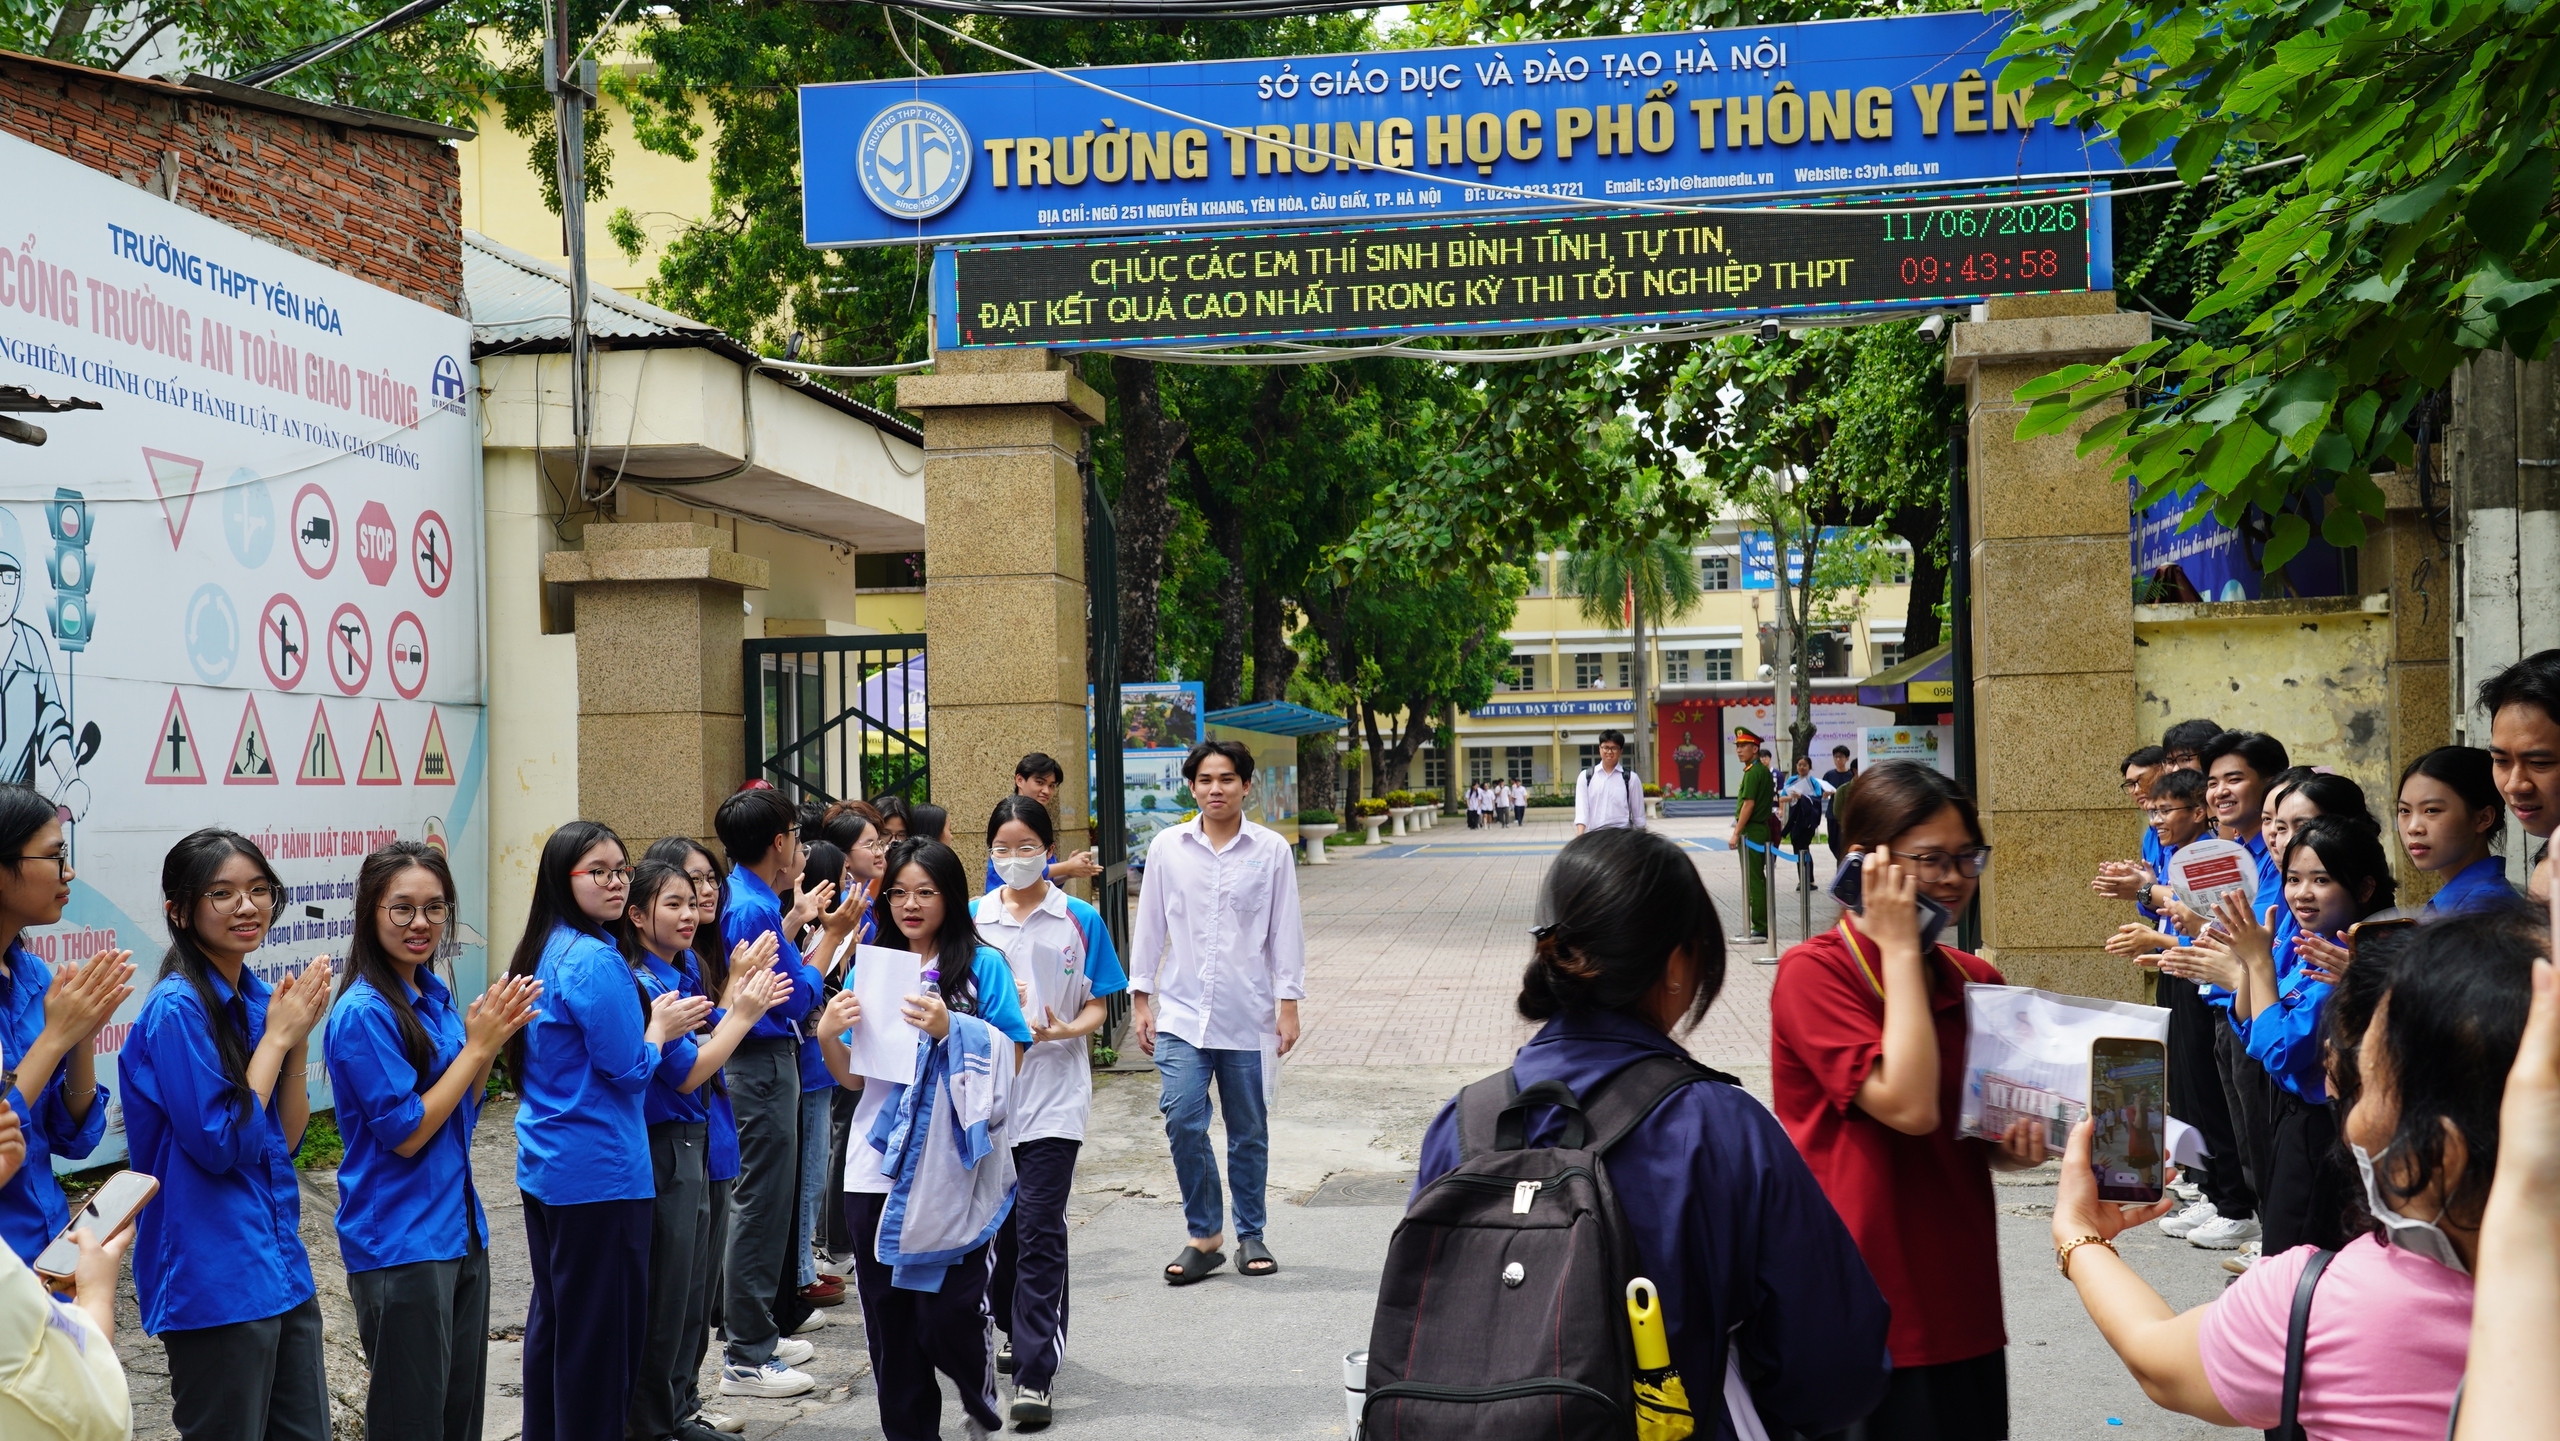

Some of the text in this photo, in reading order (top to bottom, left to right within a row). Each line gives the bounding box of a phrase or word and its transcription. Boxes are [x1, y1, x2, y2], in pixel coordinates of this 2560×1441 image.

[1258, 36, 1787, 99] SỞ GIÁO DỤC VÀ ĐÀO TẠO HÀ NỘI
[867, 109, 958, 152] TRƯỜNG THPT YÊN HÒA
[984, 118, 1209, 188] TRƯỜNG
[1223, 116, 1415, 177] TRUNG
[1426, 109, 1543, 175] HỌC
[1556, 79, 1679, 159] PHỔ
[1690, 80, 1894, 152] THÔNG
[1911, 68, 2036, 136] YÊN
[895, 194, 939, 210] since 1960
[1038, 208, 1060, 227] ĐỊA
[1091, 205, 1118, 221] NGÕ
[1121, 205, 1144, 220] 251
[1147, 197, 1198, 219] NGUYỄN
[1201, 200, 1248, 217] KHANG,
[1251, 196, 1275, 213] YÊN
[1278, 194, 1308, 213] HÒA,
[1310, 192, 1336, 210] CẦU
[1339, 190, 1370, 210] GIẤY,
[1374, 192, 1394, 207] TP.
[1396, 187, 1415, 205] HÀ
[1418, 188, 1442, 208] NỘI
[1464, 187, 1485, 202] ĐT:
[1552, 181, 1583, 197] 3721
[1605, 177, 1645, 194] Email:
[1794, 164, 1853, 183] Website:
[1854, 161, 1940, 180] c3yh.edu.vn
[1883, 203, 2077, 241] 11/06/2026
[1091, 249, 1179, 284] CHÚC
[1186, 246, 1247, 280] CÁC
[1254, 250, 1299, 277] EM
[1305, 238, 1358, 274] THÍ
[1366, 242, 1438, 272] SINH
[1448, 232, 1523, 267] BÌNH
[1622, 229, 1669, 262] TỰ
[1672, 226, 1731, 256] TIN,
[1901, 250, 2058, 284] 09:43:58
[107, 222, 343, 336] TRƯỜNG THPT YÊN HÒA
[978, 258, 1855, 333] ĐẠT KẾT QUẢ CAO NHẤT TRONG KỲ THI TỐT NGHIỆP THPT
[0, 233, 419, 431] CỔNG TRƯỜNG AN TOÀN GIAO THÔNG
[0, 335, 420, 471] NGHIÊM CHỈNH CHẤP HÀNH LUẬT AN TOÀN GIAO THÔNG
[360, 523, 394, 562] STOP
[1499, 705, 1522, 715] ĐUA
[1526, 704, 1548, 716] DẠY
[1552, 701, 1576, 713] TỐT
[1589, 702, 1612, 714] HỌC
[282, 827, 311, 859] HÀNH
[314, 826, 339, 863] LUẬT
[341, 830, 364, 856] GIAO
[296, 880, 314, 905] quán
[316, 879, 335, 901] trước
[336, 874, 354, 901] cổng
[62, 925, 116, 961] THÔNG
[267, 924, 291, 946] ngang
[293, 920, 305, 942] khi
[306, 919, 325, 940] tham
[327, 917, 338, 940] gia
[270, 962, 283, 984] khi
[94, 1020, 135, 1054] HÔN
